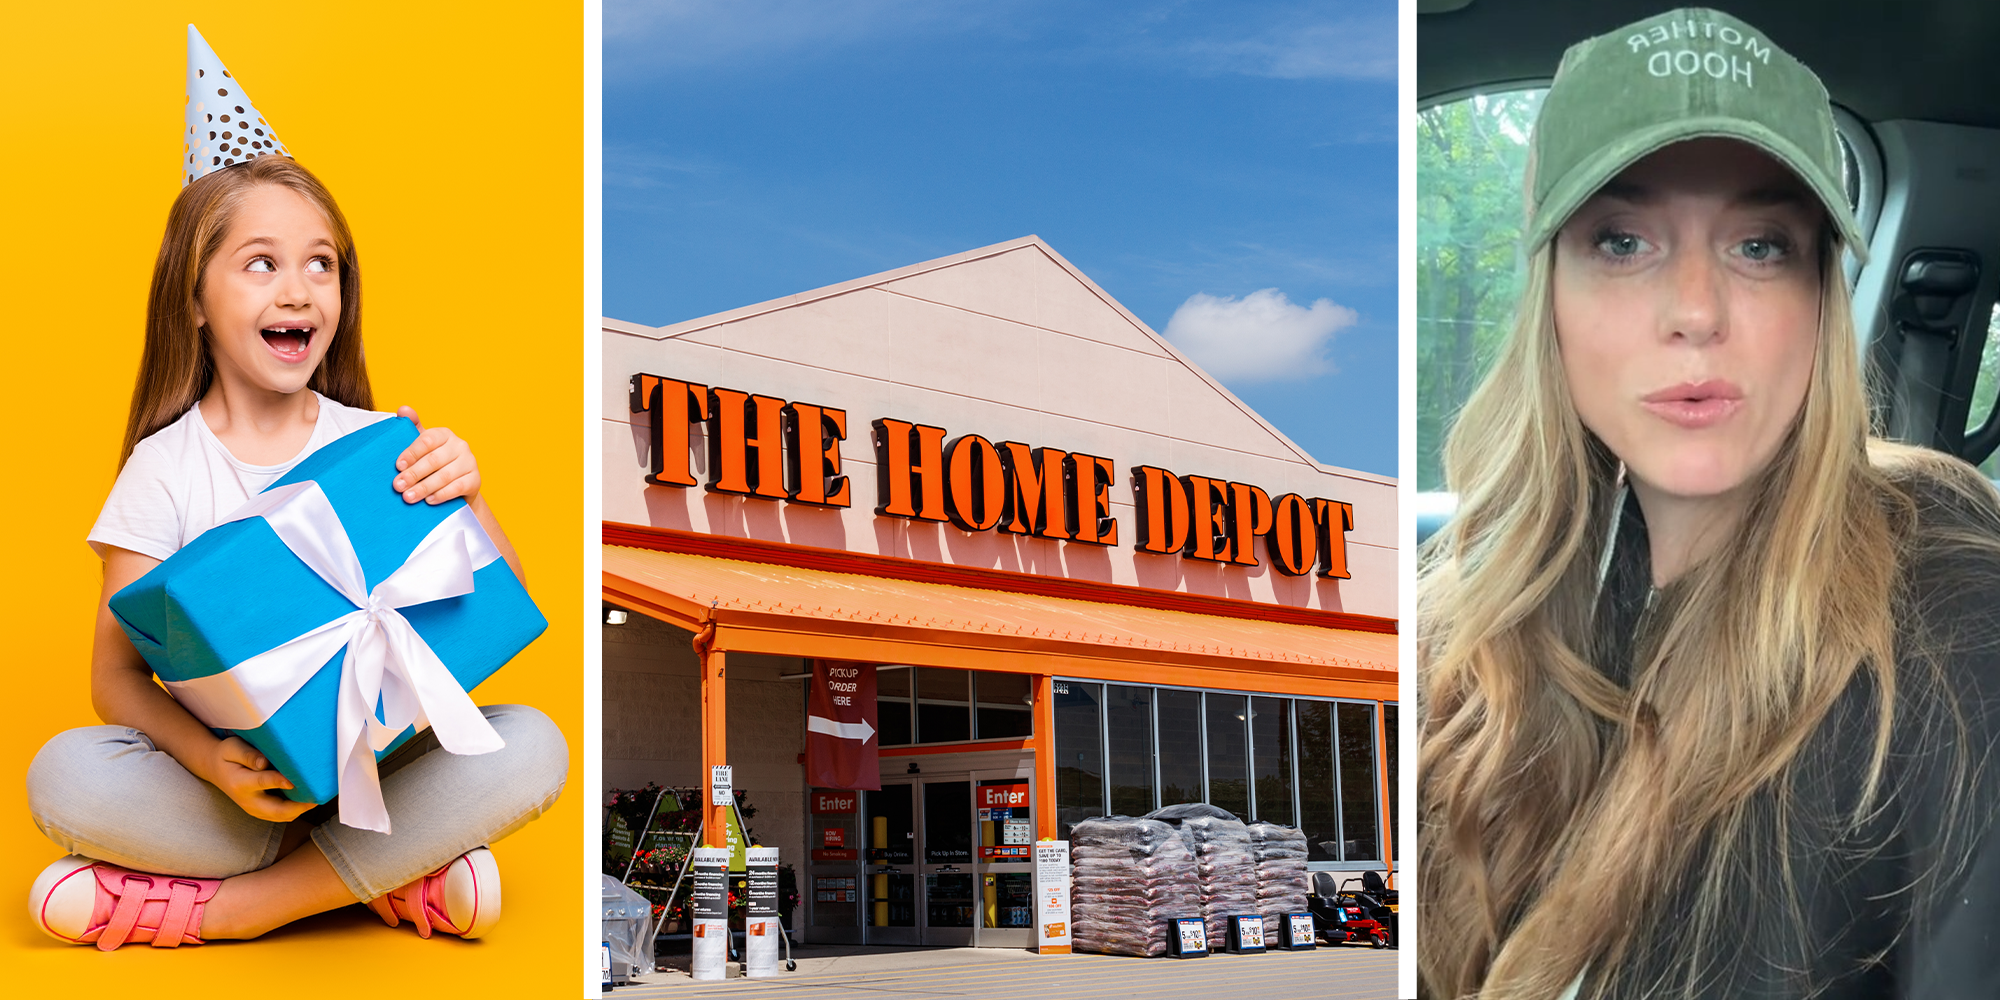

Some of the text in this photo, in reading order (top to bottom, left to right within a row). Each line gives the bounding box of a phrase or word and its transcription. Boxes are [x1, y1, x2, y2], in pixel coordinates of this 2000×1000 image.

[630, 372, 1353, 580] THE HOME DEPOT
[829, 667, 859, 678] PICKUP
[828, 680, 857, 692] ORDER
[832, 695, 851, 706] HERE
[986, 788, 1025, 804] Enter
[820, 796, 853, 810] Enter
[884, 851, 892, 859] Buy
[1182, 931, 1185, 939] 5
[1242, 927, 1245, 935] 5
